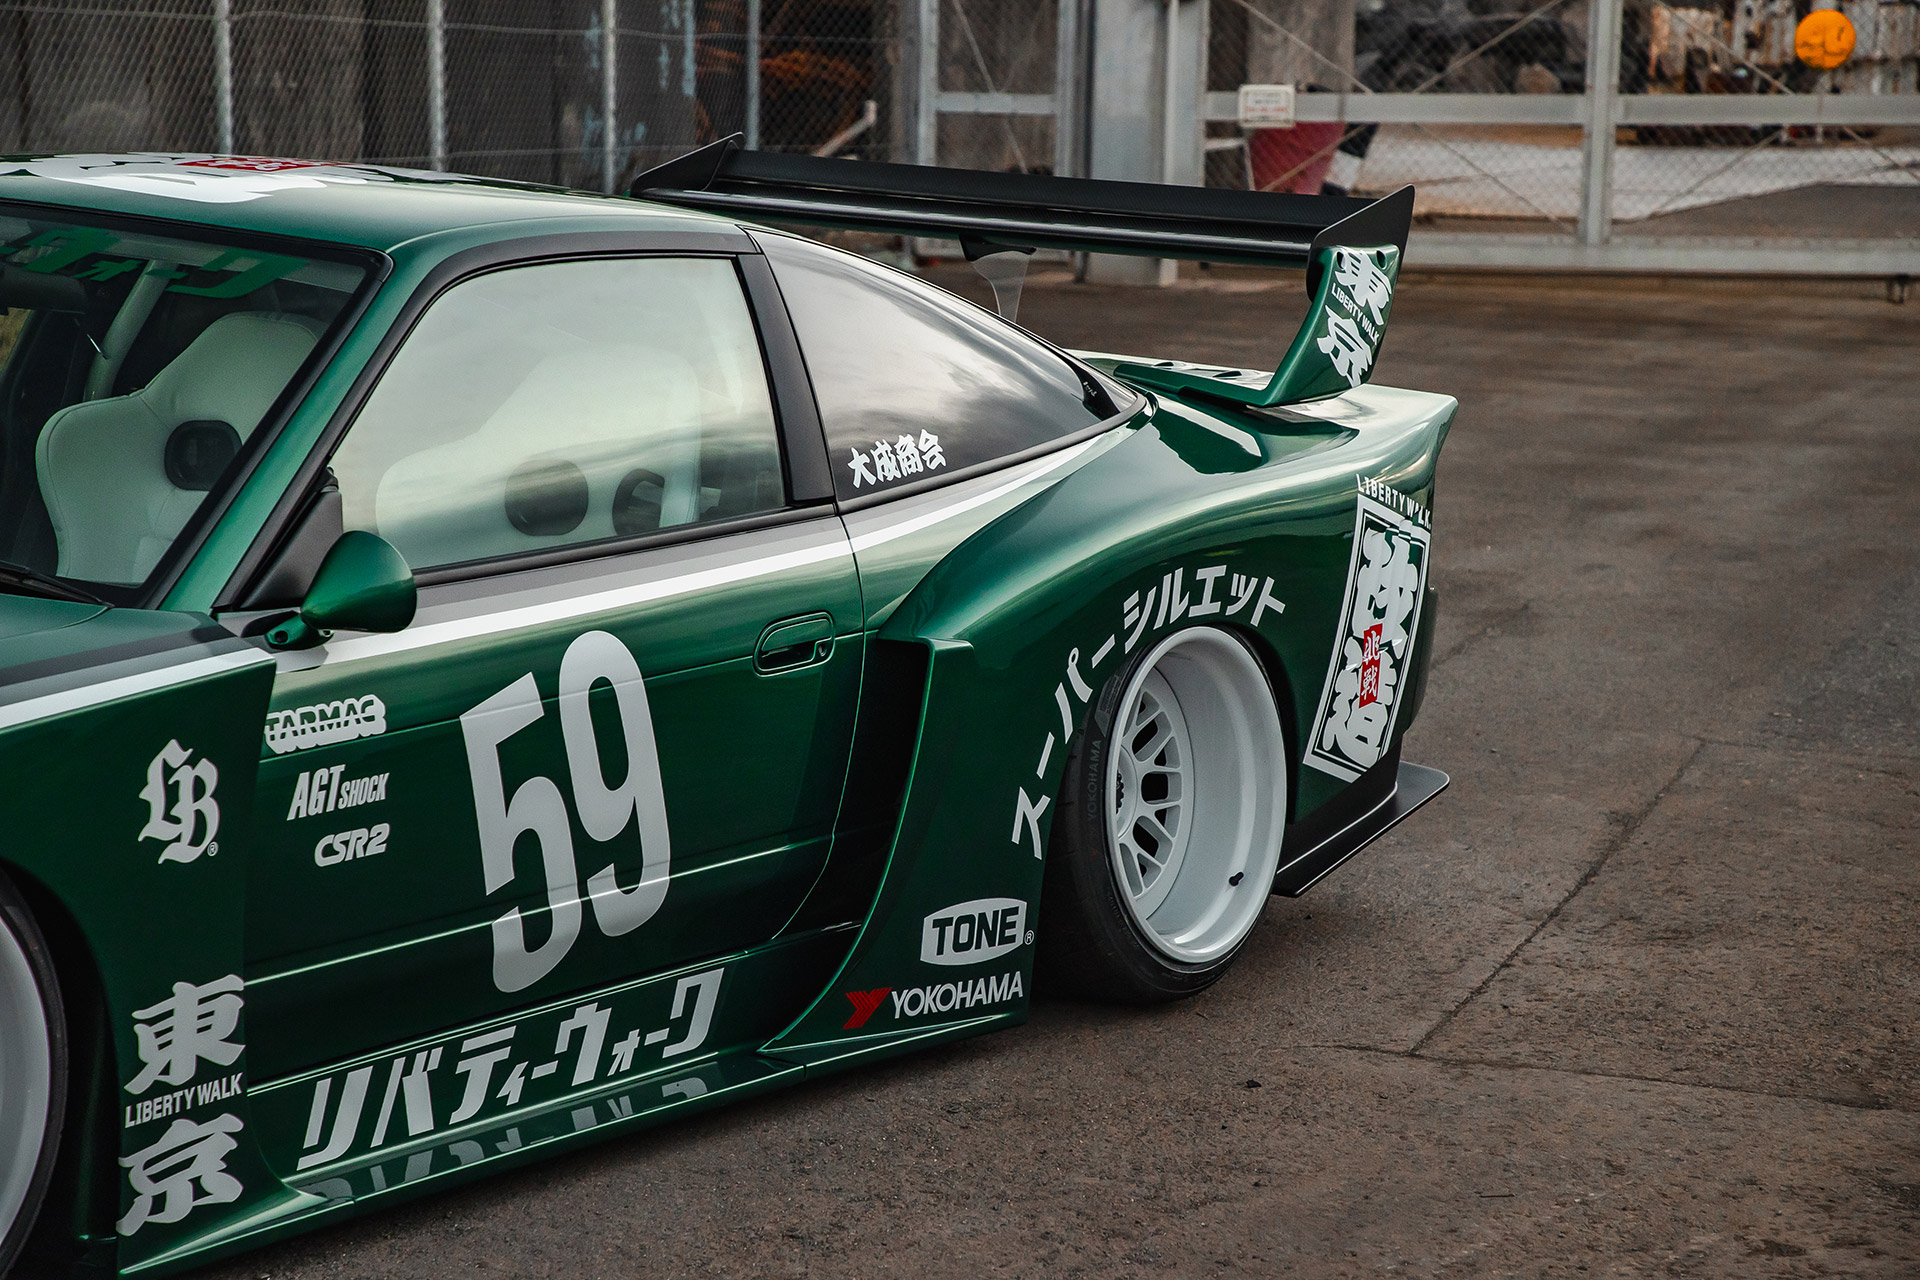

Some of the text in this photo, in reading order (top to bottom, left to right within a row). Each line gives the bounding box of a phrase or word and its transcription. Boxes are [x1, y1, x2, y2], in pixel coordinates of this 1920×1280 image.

[1331, 283, 1380, 346] LIBERTY WALK
[1334, 247, 1393, 326] 東
[1316, 304, 1373, 389] 京
[847, 429, 947, 489] 大成商会
[1356, 473, 1405, 513] LIBERTY
[265, 697, 380, 746] TARMAC
[1011, 564, 1287, 861] スーパーシルエット
[286, 763, 390, 821] AGT SHOCK
[459, 629, 671, 993] 59
[1086, 738, 1102, 820] YOKOHAMA
[314, 822, 391, 867] CSR2
[891, 970, 1024, 1020] YOKOHAMA
[123, 973, 247, 1096] 東
[296, 967, 725, 1171] リバティーウォーク
[124, 1071, 243, 1129] LIBERTY WALK
[115, 1112, 245, 1237] 京
